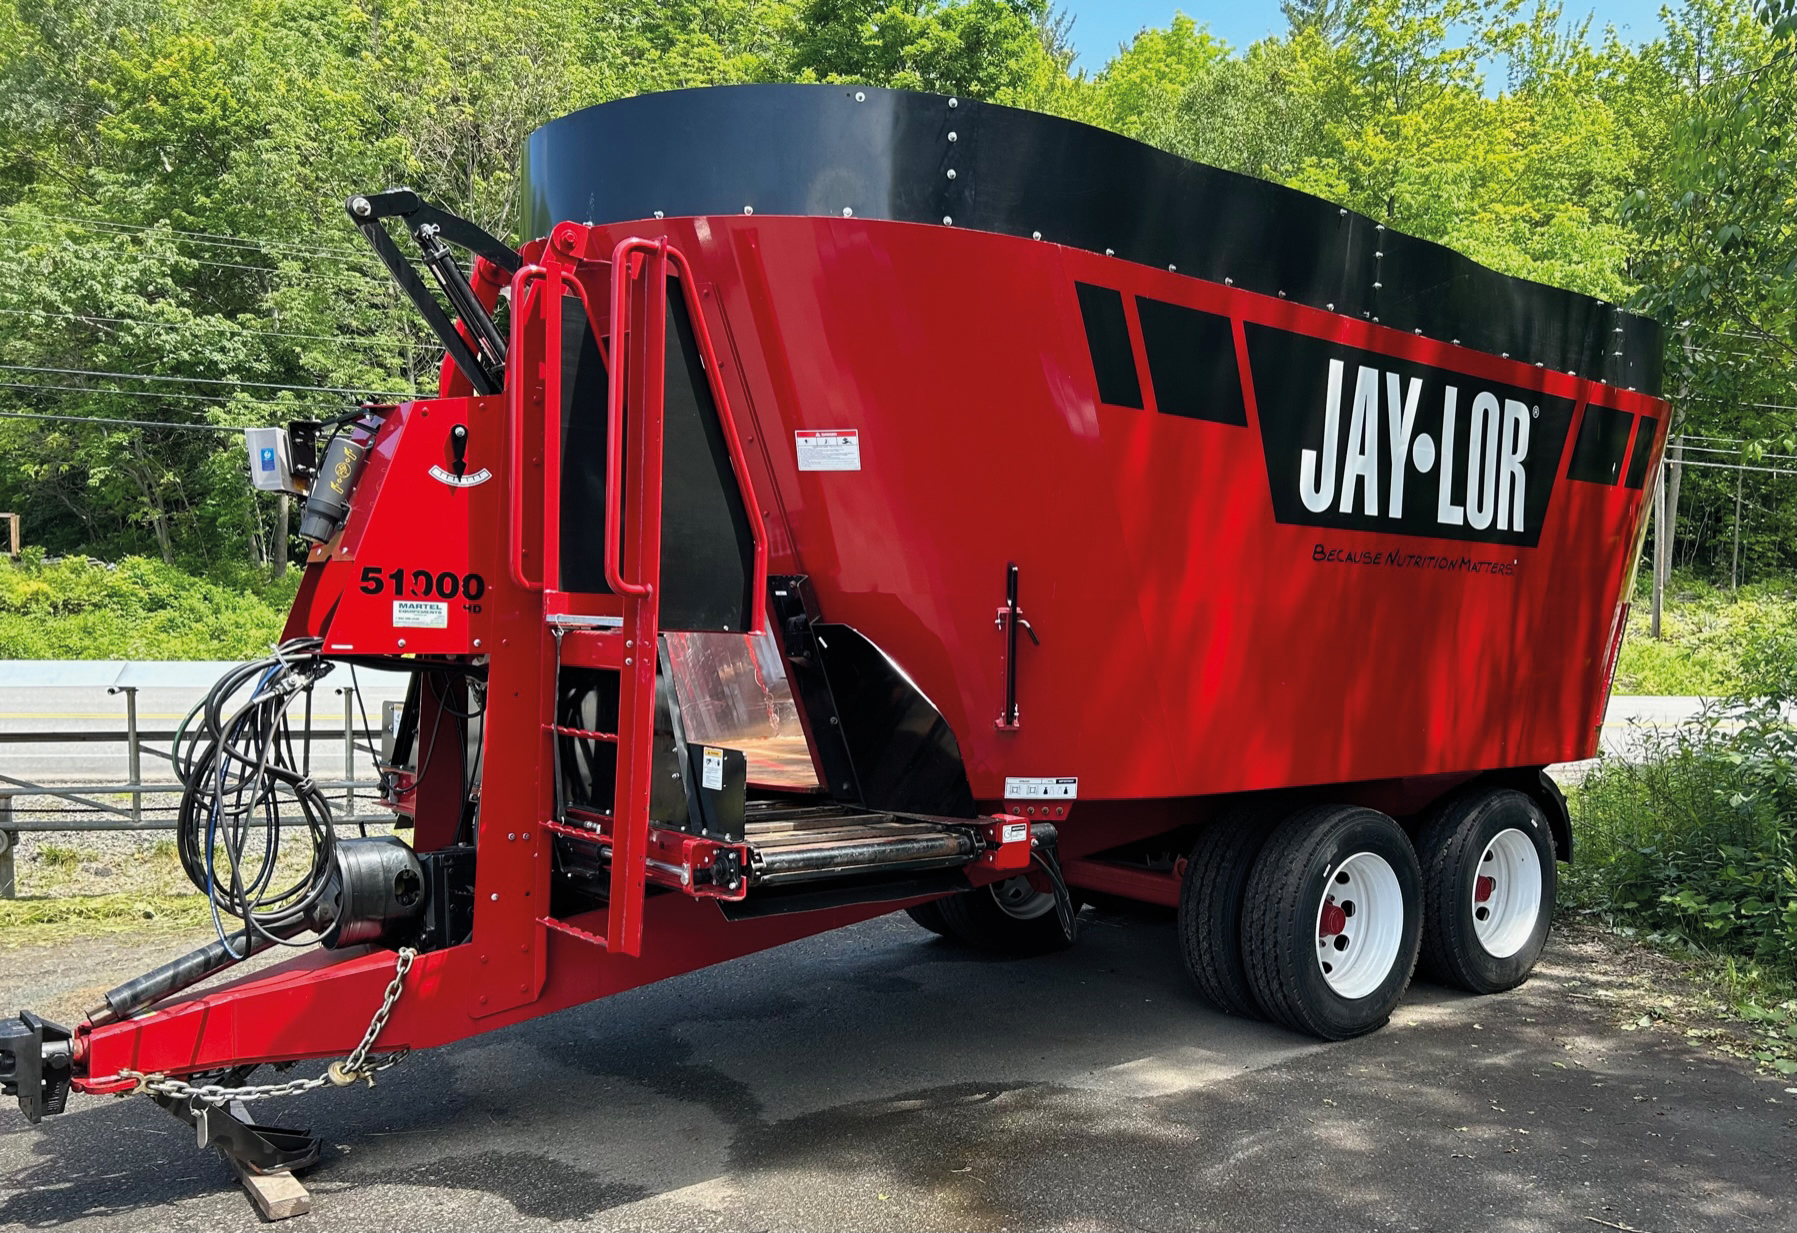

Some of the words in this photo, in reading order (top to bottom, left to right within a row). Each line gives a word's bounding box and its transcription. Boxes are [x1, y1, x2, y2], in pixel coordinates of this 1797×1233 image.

[1312, 544, 1382, 565] BECAUSE
[1384, 548, 1458, 571] NUTRITION
[360, 566, 485, 600] 51000
[398, 602, 442, 610] MARTEL
